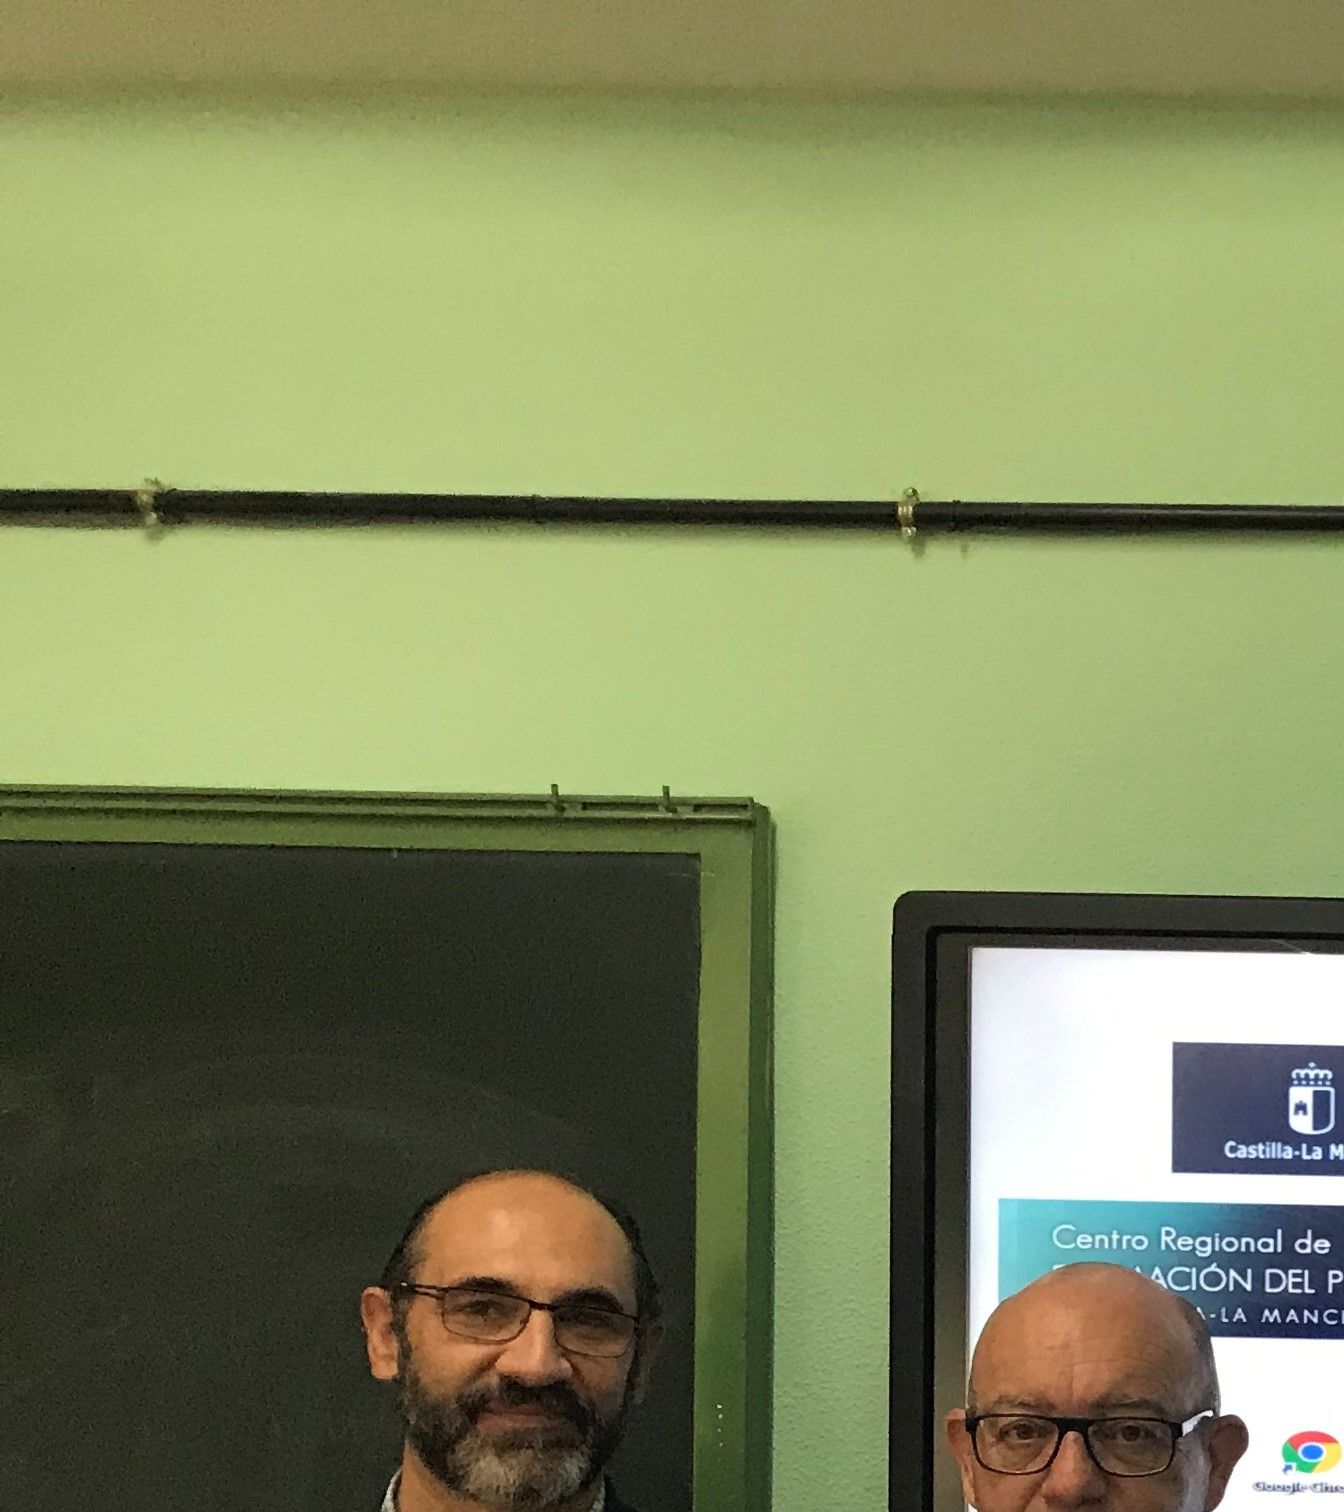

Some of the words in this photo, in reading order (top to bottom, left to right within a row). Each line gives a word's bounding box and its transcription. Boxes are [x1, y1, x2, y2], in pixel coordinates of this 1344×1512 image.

[1223, 1140, 1323, 1161] Castilla-La
[1052, 1224, 1149, 1251] Centro
[1160, 1226, 1284, 1257] Regional
[1294, 1230, 1332, 1254] de
[1265, 1268, 1316, 1294] DEL
